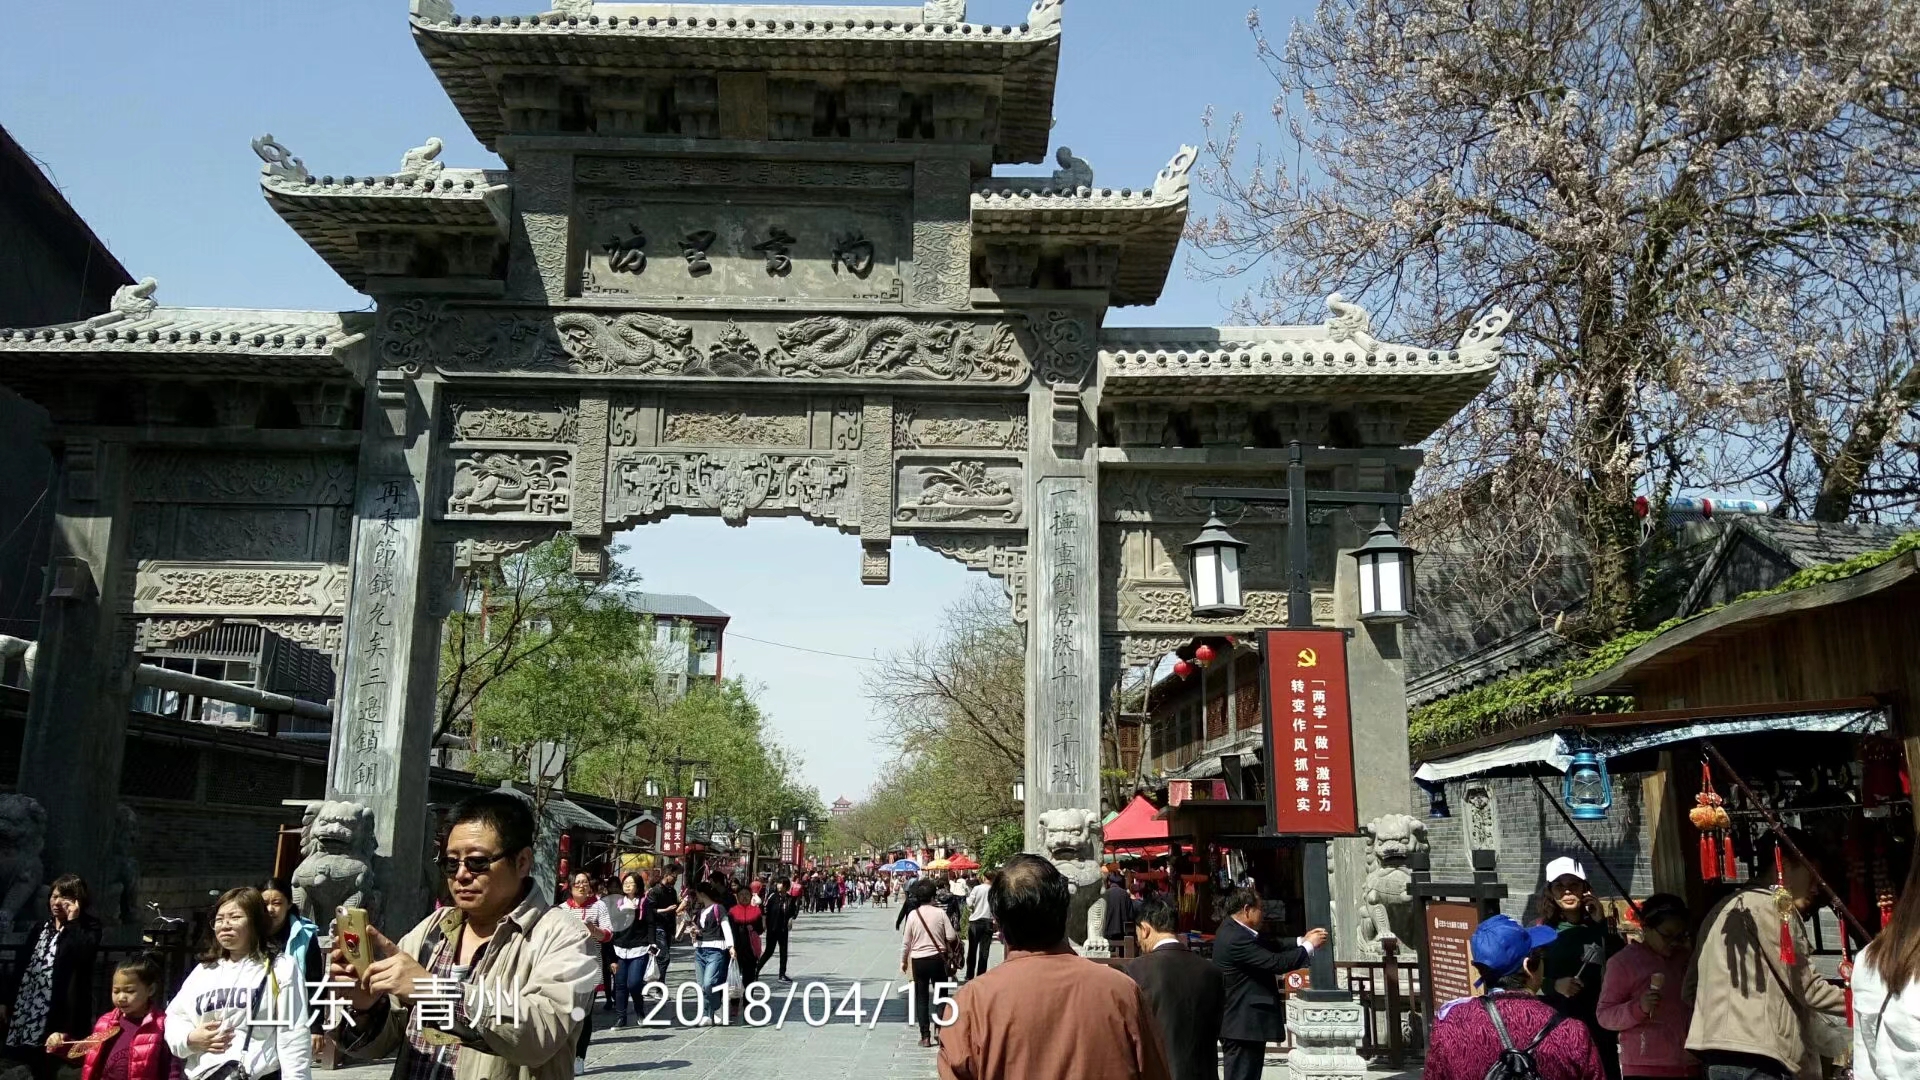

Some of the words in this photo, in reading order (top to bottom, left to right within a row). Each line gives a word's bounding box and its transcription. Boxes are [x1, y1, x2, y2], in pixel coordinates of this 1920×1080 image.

[1291, 679, 1310, 812] 转变作风抓落实
